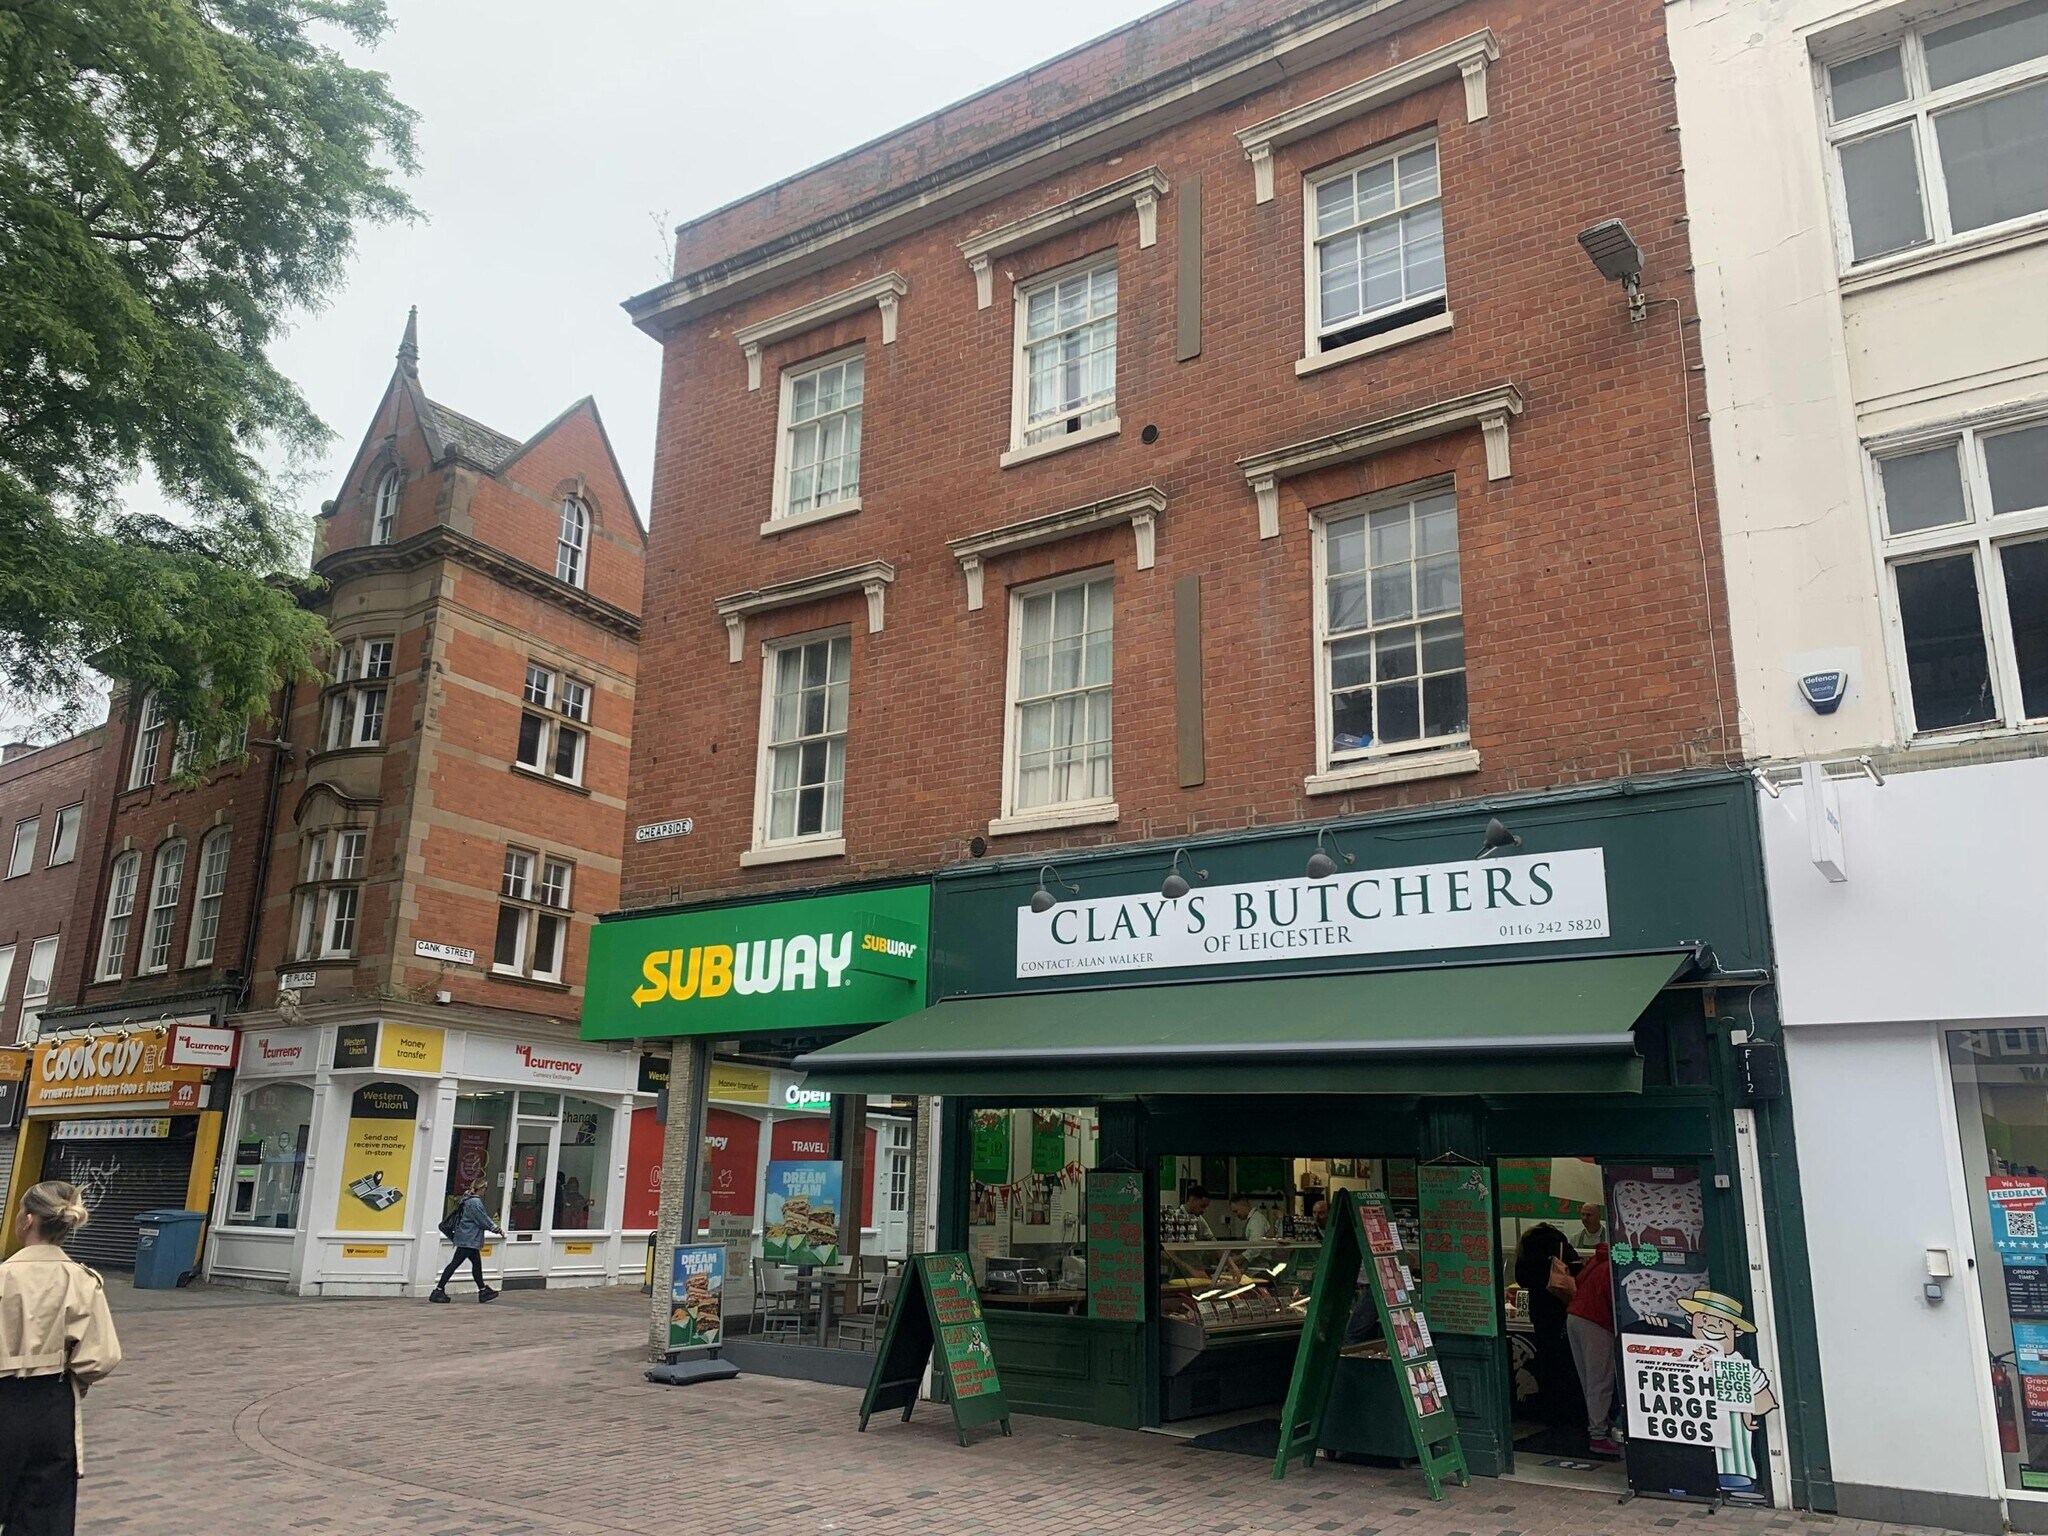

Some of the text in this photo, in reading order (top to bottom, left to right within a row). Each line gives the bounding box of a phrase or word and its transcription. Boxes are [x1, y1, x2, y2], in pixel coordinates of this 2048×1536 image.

[1805, 673, 1838, 684] defence
[1811, 684, 1834, 693] security
[639, 822, 688, 839] CHEAPSIDE
[1051, 862, 1553, 945] CLAY'S BUTCHERS
[1499, 919, 1601, 937] 0116 242 5820
[1203, 925, 1353, 953] OF LEICESTER
[418, 942, 473, 958] CANK STREET
[861, 934, 917, 958] SUBWAY
[1021, 953, 1154, 972] CONTACT: ALAN WALKER
[631, 931, 853, 1008] SUBWAY
[294, 972, 314, 981] PLACE
[190, 1042, 230, 1052] currency
[344, 1038, 366, 1047] Western
[400, 1038, 426, 1049] Money
[267, 1046, 302, 1058] currency
[348, 1046, 365, 1055] Union
[397, 1049, 427, 1060] transfer
[531, 1058, 582, 1075] currency
[533, 1071, 572, 1081] Currency Exchange
[40, 1087, 73, 1099] AUTHENTIC
[74, 1085, 94, 1098] ASIAN
[94, 1083, 119, 1097] STREET
[120, 1082, 137, 1094] FOOD
[718, 1079, 758, 1090] Money transfer
[363, 1091, 403, 1100] Western
[374, 1101, 402, 1109] Union
[364, 1133, 382, 1141] Send
[792, 1141, 825, 1153] TRAVEL
[783, 1172, 826, 1184] DREAM
[788, 1184, 821, 1196] TEAM
[1991, 1189, 2044, 1199] FEEDBACK
[1424, 1233, 1490, 1254] £2.99
[681, 1253, 717, 1265] DREAM
[684, 1264, 713, 1274] TEAM
[1424, 1261, 1440, 1283] 2
[1462, 1266, 1491, 1286] £5
[1627, 1344, 1683, 1357] CLAY'S
[1662, 1361, 1700, 1369] BUTCHERS
[1714, 1360, 1750, 1371] FRESH
[1714, 1370, 1750, 1381] LARGE
[1638, 1370, 1715, 1397] FRESH
[1715, 1381, 1752, 1392] EGGS
[1717, 1391, 1752, 1404] £2.69
[1640, 1393, 1718, 1420] LARGE
[1647, 1416, 1713, 1442] EGGS
